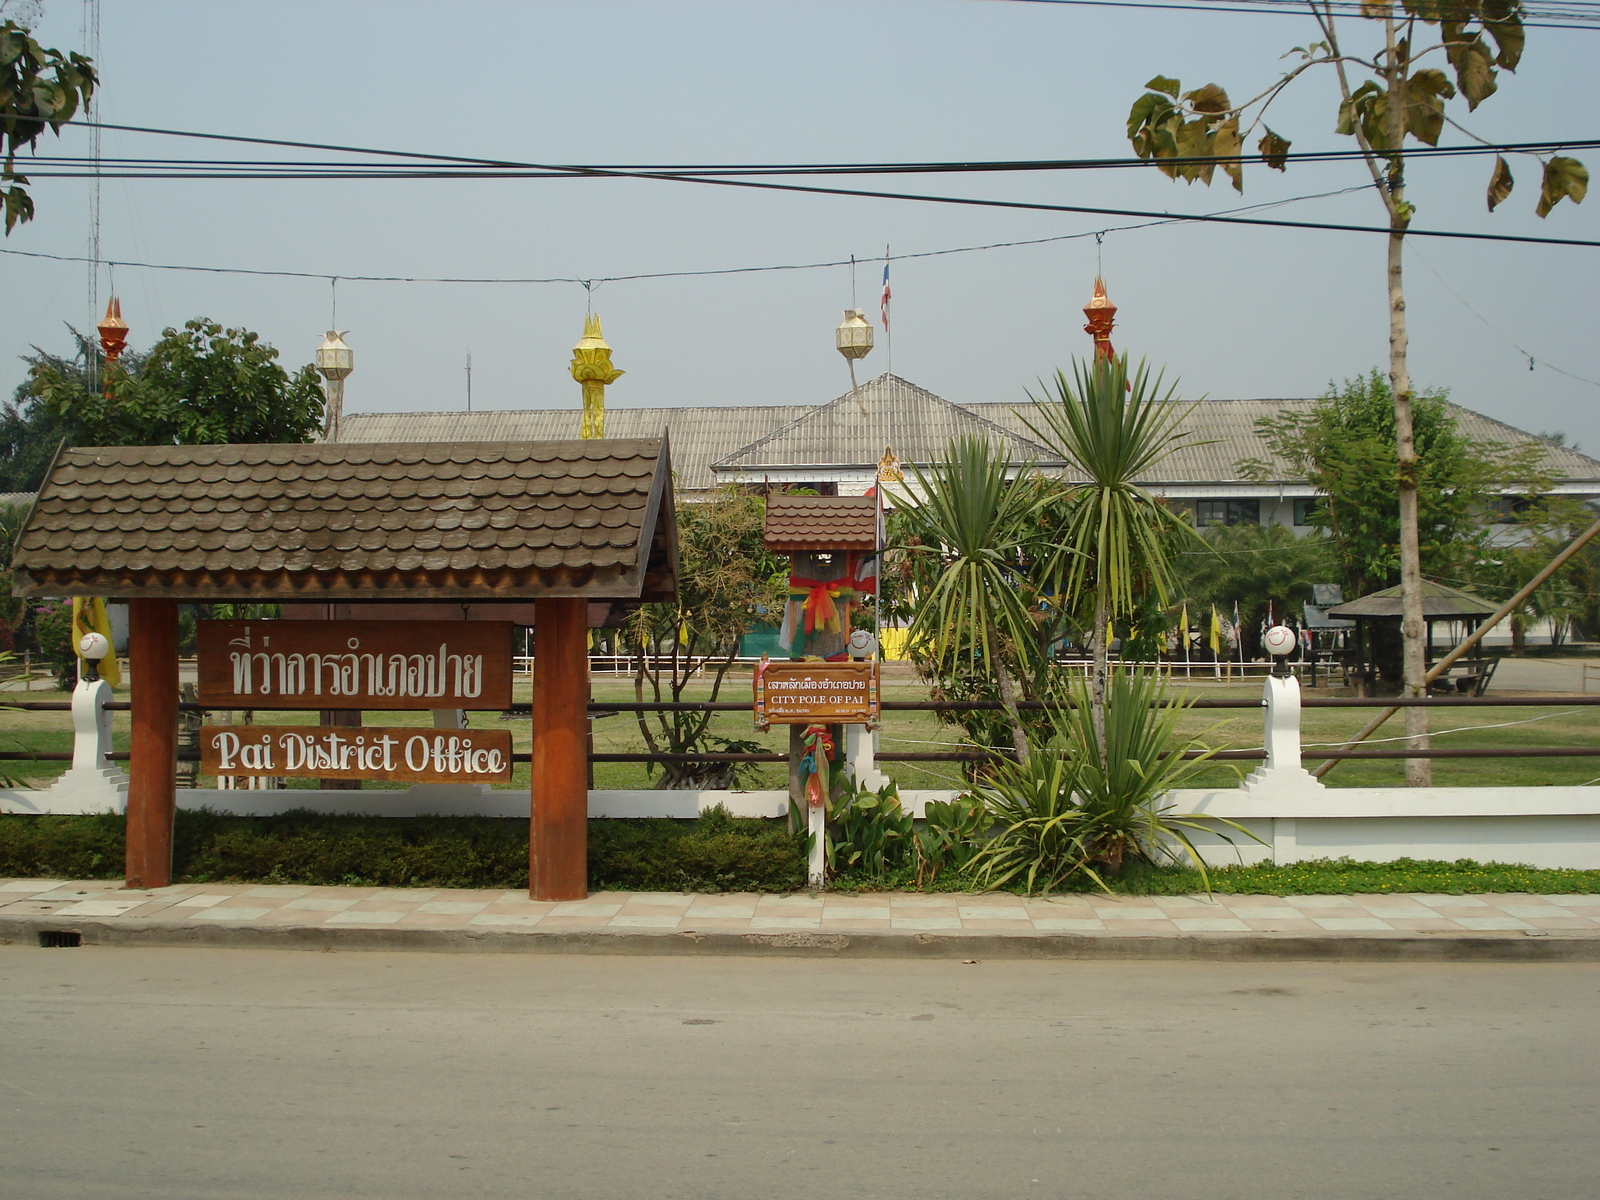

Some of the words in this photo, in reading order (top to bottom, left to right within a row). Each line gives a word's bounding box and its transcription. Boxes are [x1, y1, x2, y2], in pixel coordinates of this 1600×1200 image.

[229, 626, 483, 698] ที่ว่าการอำเภอปาย
[771, 695, 798, 704] CITY
[798, 695, 827, 704] POLE
[828, 695, 843, 704] OF
[844, 695, 864, 704] PAI
[211, 731, 276, 770] Pai
[278, 732, 400, 772] District
[404, 734, 507, 774] Office
